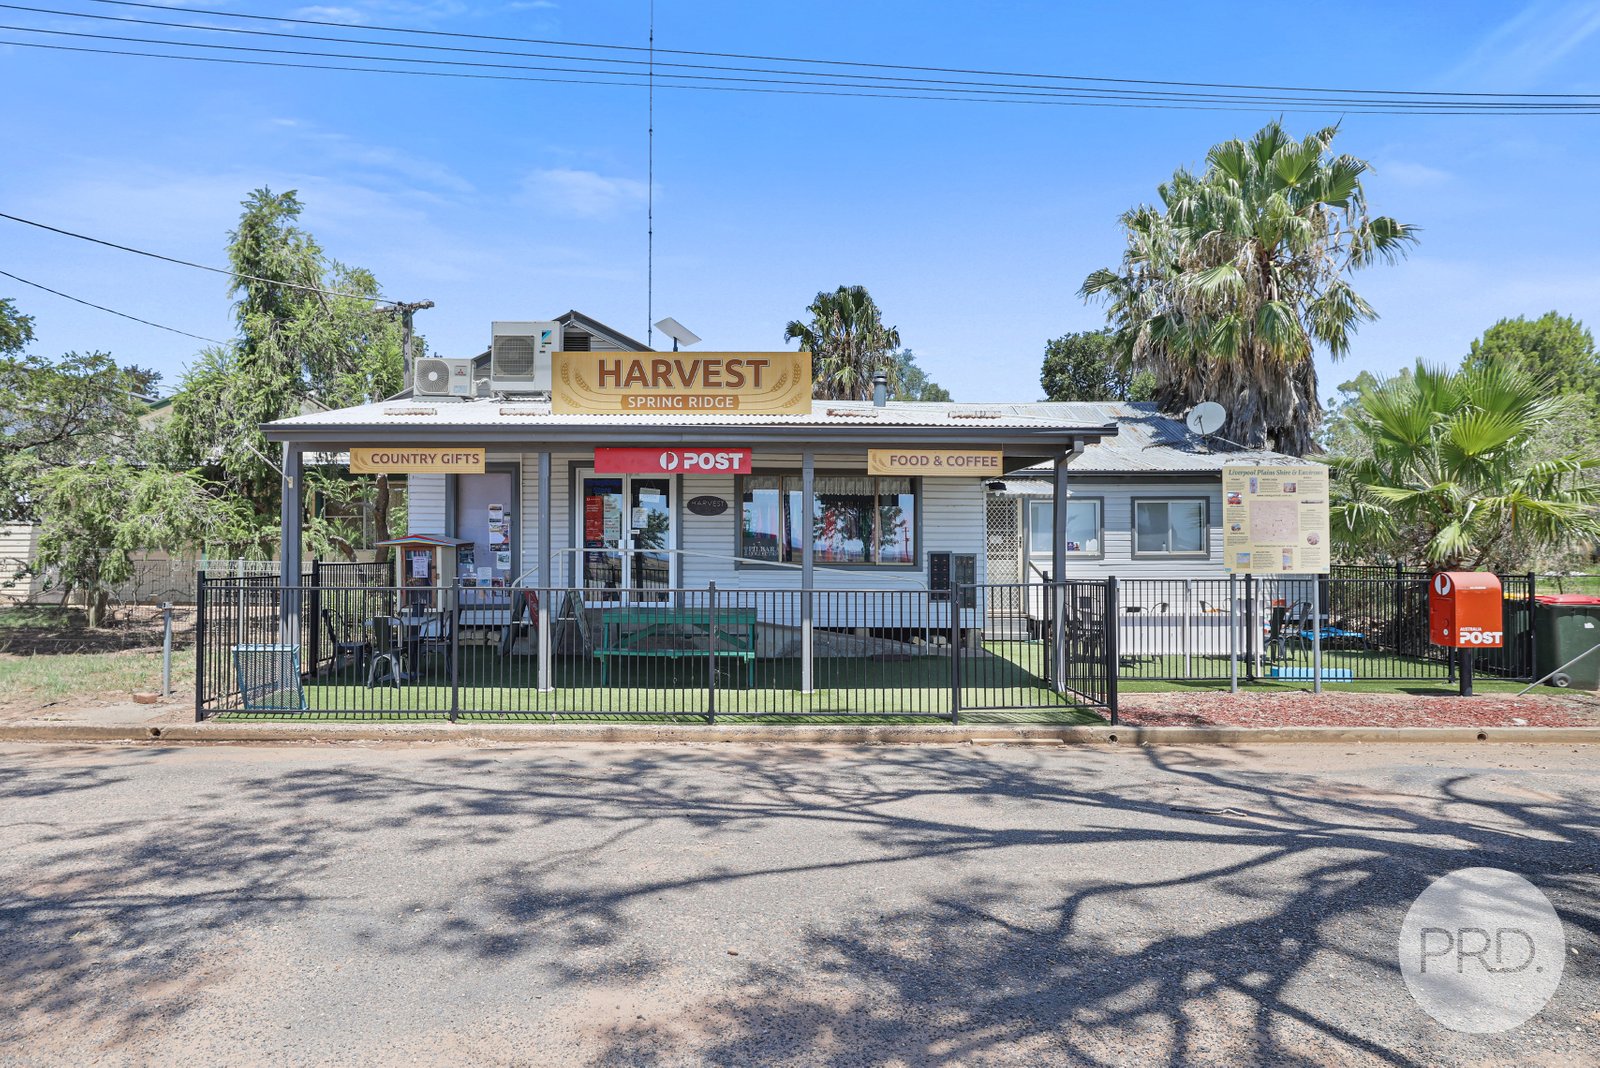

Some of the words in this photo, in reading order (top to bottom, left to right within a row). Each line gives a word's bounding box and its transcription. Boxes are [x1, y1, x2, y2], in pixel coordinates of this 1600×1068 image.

[598, 358, 771, 389] HARVEST
[628, 396, 683, 408] SPRING
[688, 396, 734, 408] RIDGE
[371, 453, 437, 464] COUNTRY
[441, 453, 480, 464] GIFTS
[683, 452, 744, 470] POST
[890, 455, 929, 466] FOOD
[933, 455, 942, 466] &
[946, 455, 998, 467] COFFEE
[1228, 469, 1256, 477] Liverpool
[1460, 632, 1503, 644] POST
